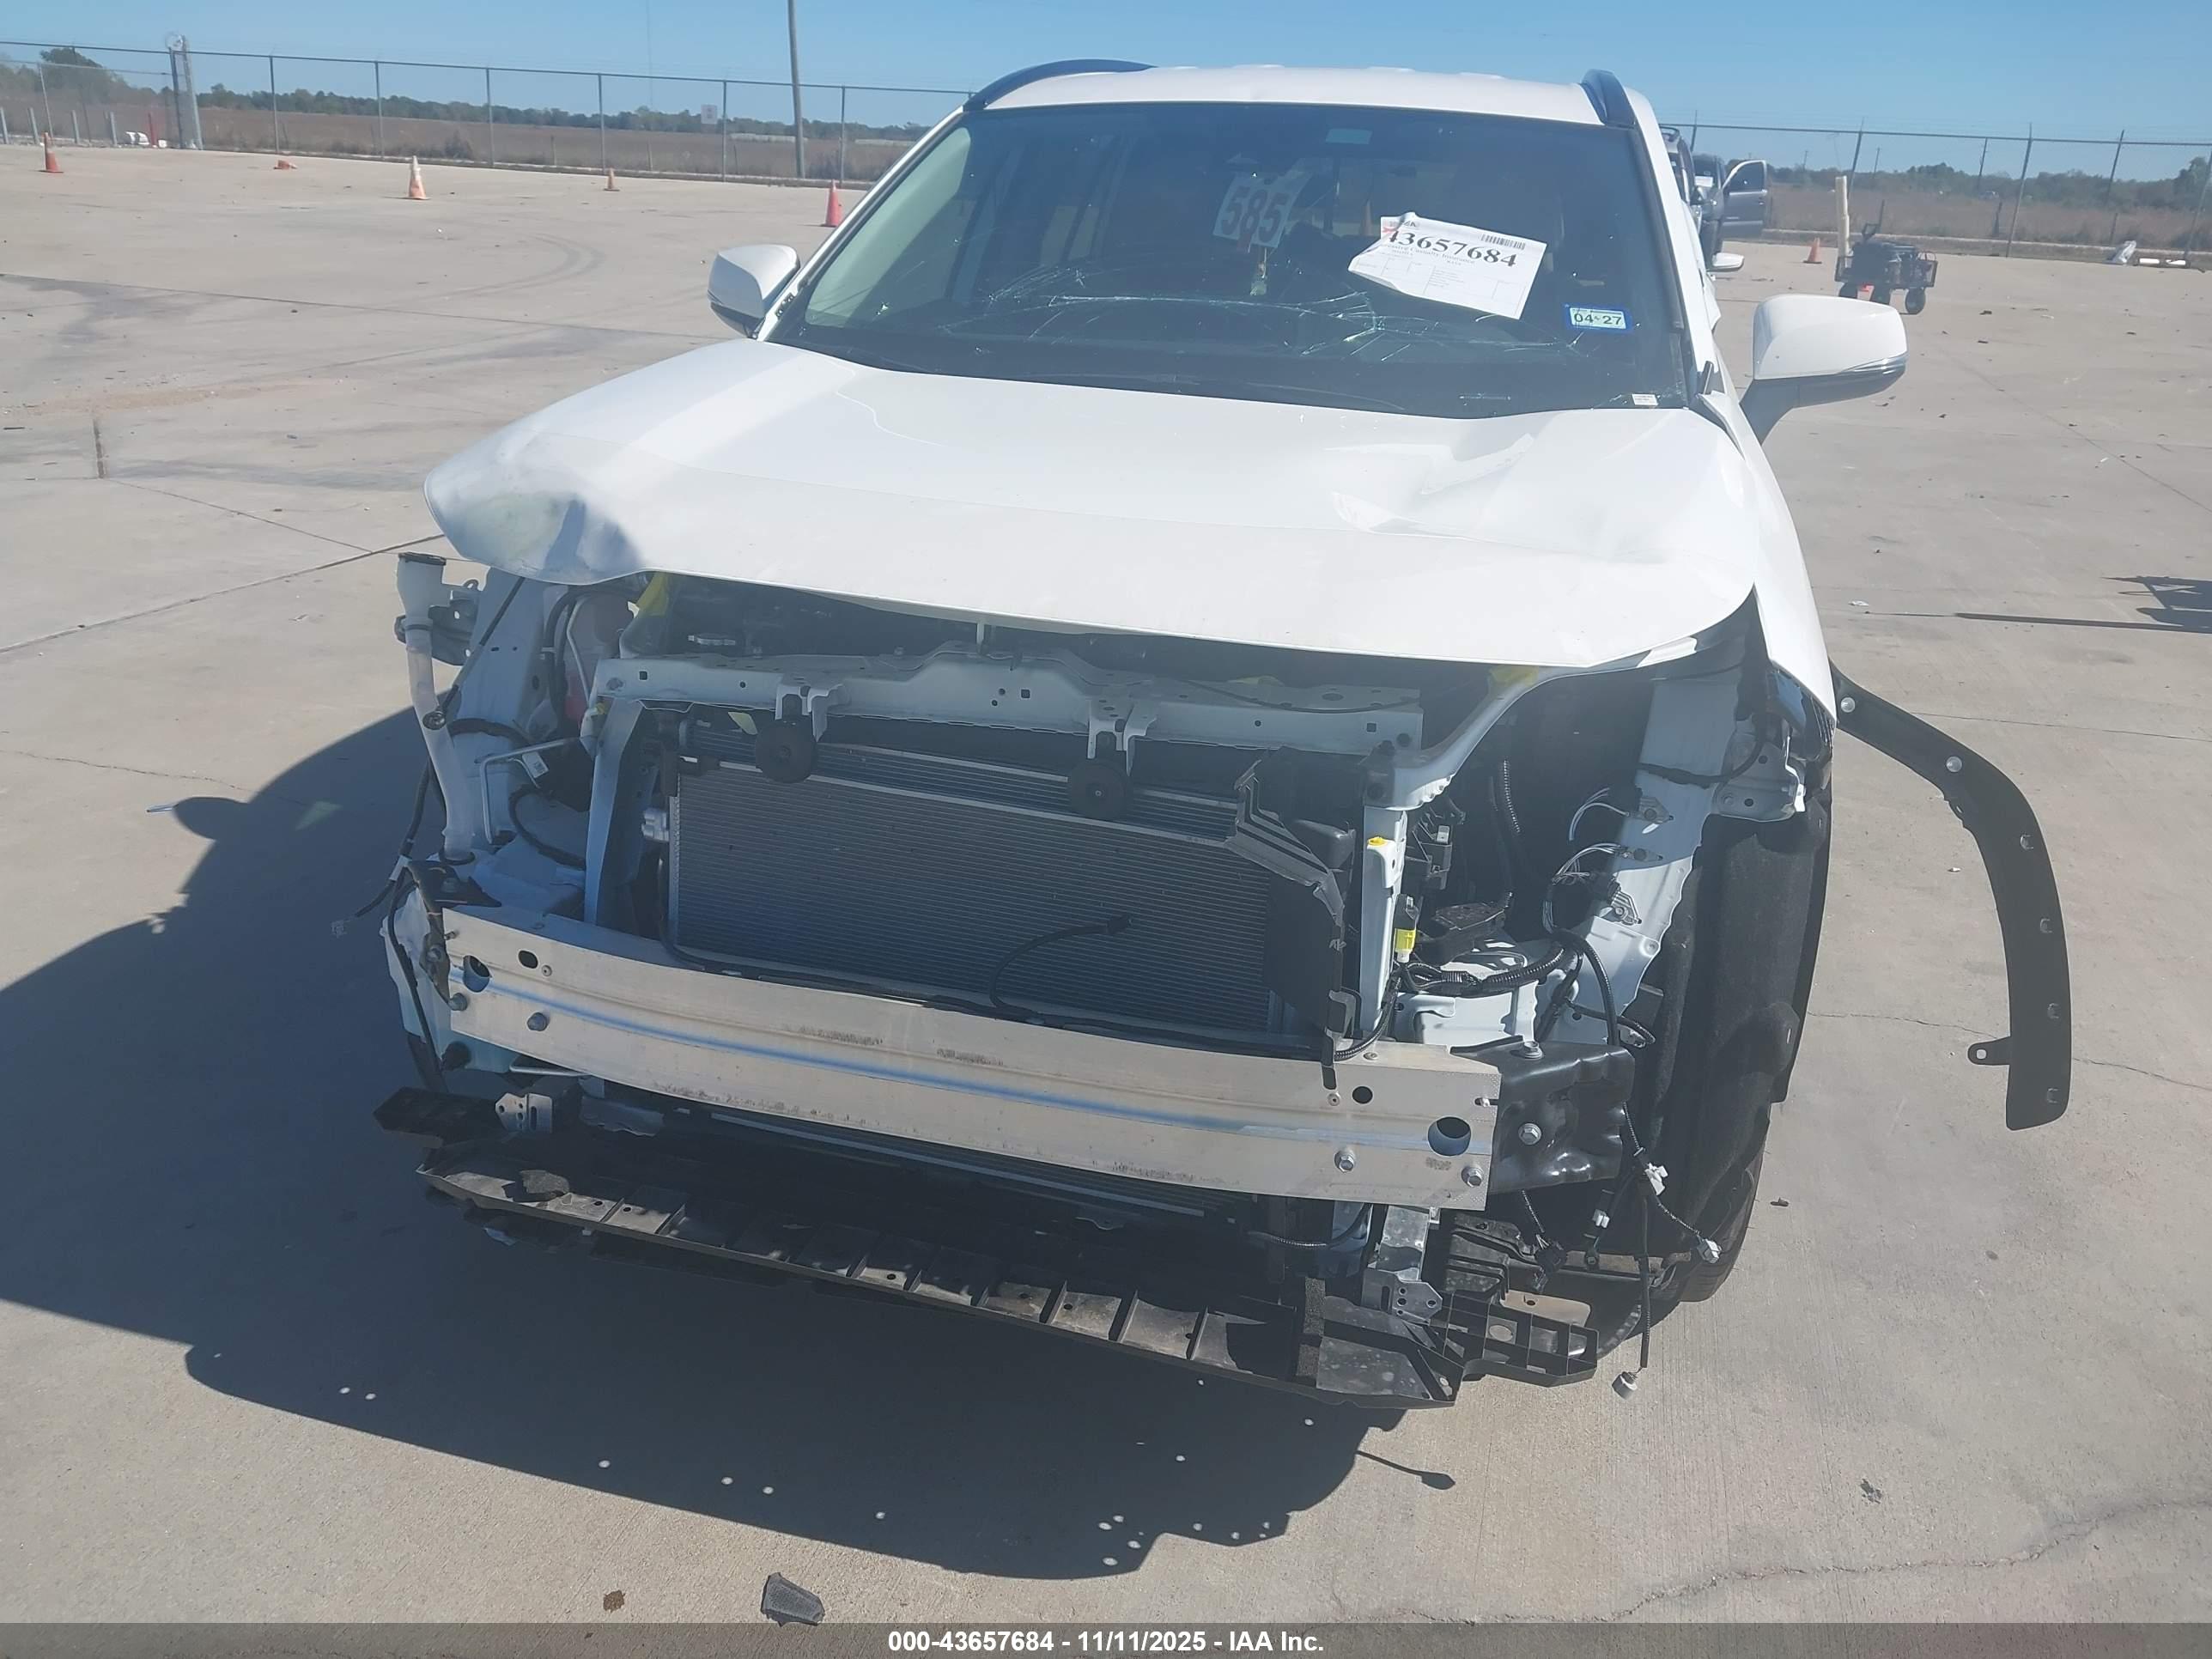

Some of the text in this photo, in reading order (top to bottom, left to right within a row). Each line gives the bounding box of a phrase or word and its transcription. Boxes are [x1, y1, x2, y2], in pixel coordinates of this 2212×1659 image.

[1221, 185, 1291, 243] 585
[1573, 313, 1622, 325] 04 27
